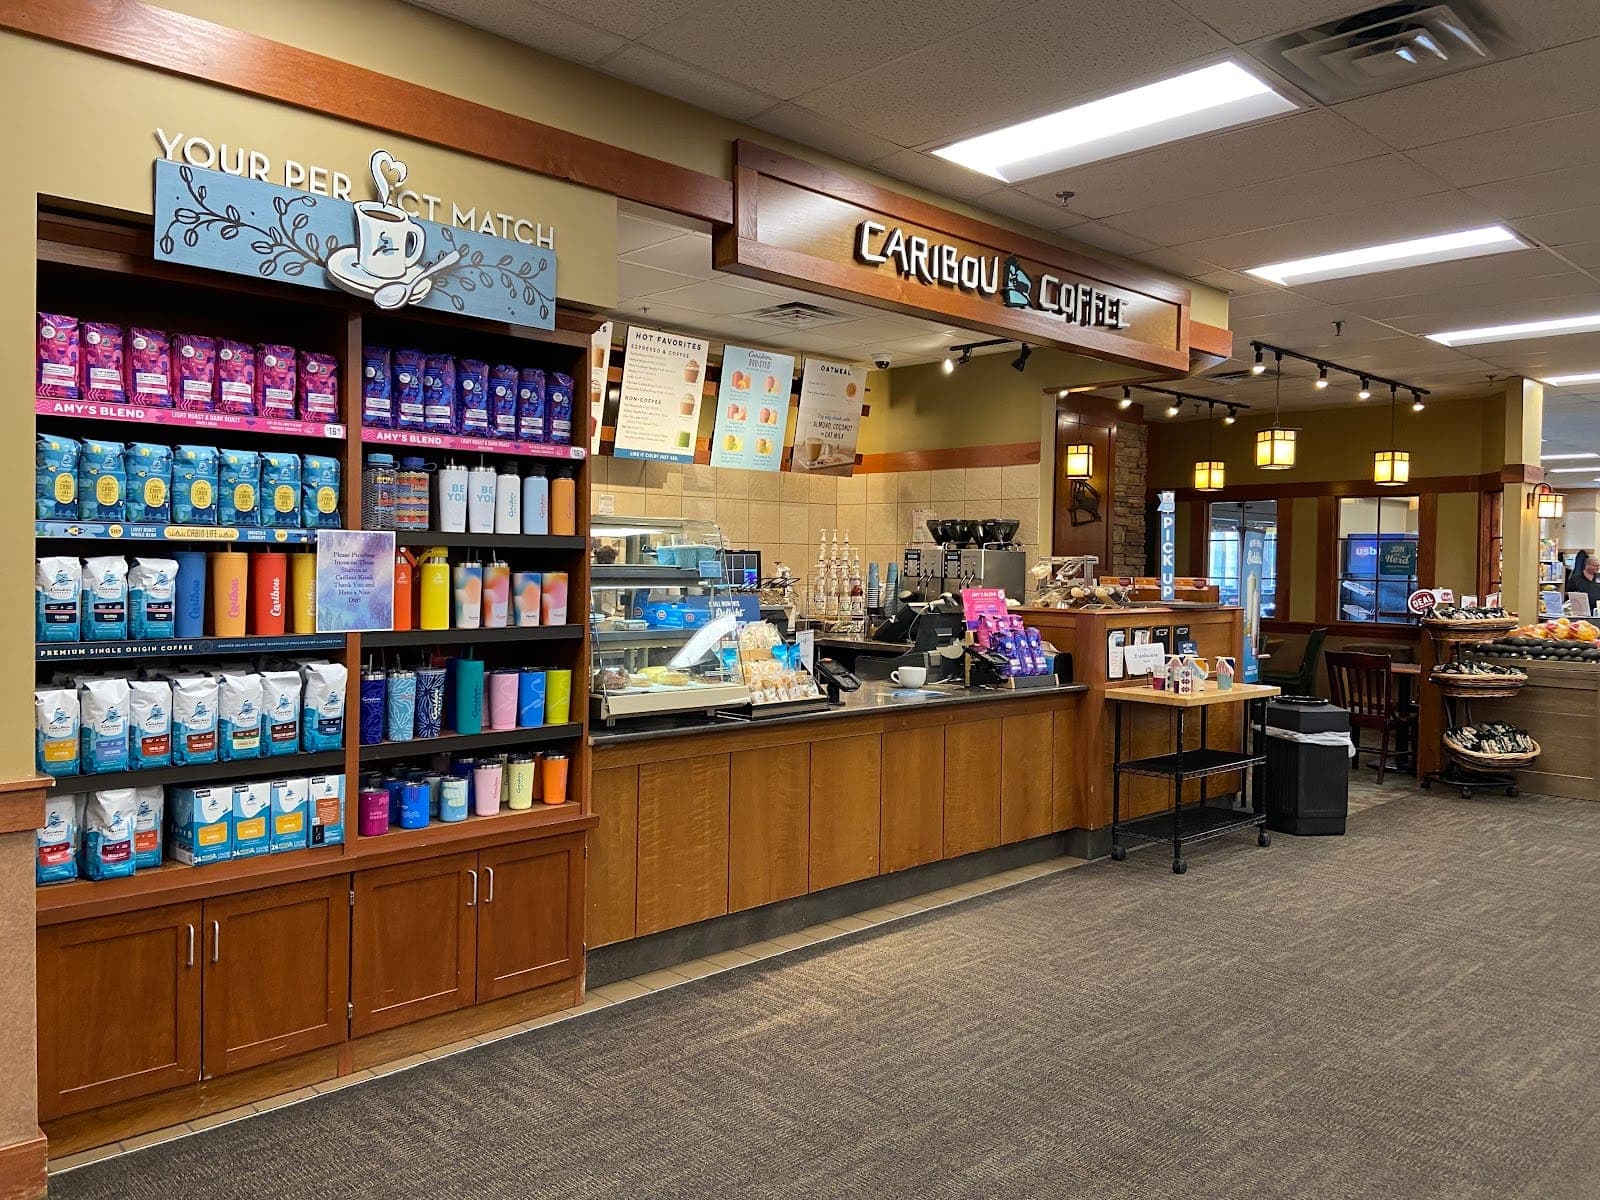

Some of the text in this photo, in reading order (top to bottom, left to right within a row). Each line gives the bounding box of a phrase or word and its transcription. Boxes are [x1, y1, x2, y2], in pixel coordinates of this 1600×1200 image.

[155, 127, 271, 183] YOUR
[451, 199, 555, 250] MATCH
[857, 218, 1131, 329] CARIBOU COFFEE
[635, 332, 702, 351] HOT FAVORITES
[820, 365, 852, 376] OATMEAL
[53, 402, 145, 419] AMY'S BLEND
[376, 431, 442, 446] AMY'S BLEND
[451, 484, 465, 493] BE
[480, 485, 494, 495] BE
[227, 576, 240, 619] Caribou
[269, 576, 281, 618] Caribou
[1411, 594, 1434, 608] DEAL
[40, 643, 194, 657] PREMIUM SINGLE ORIGIN COFFEE
